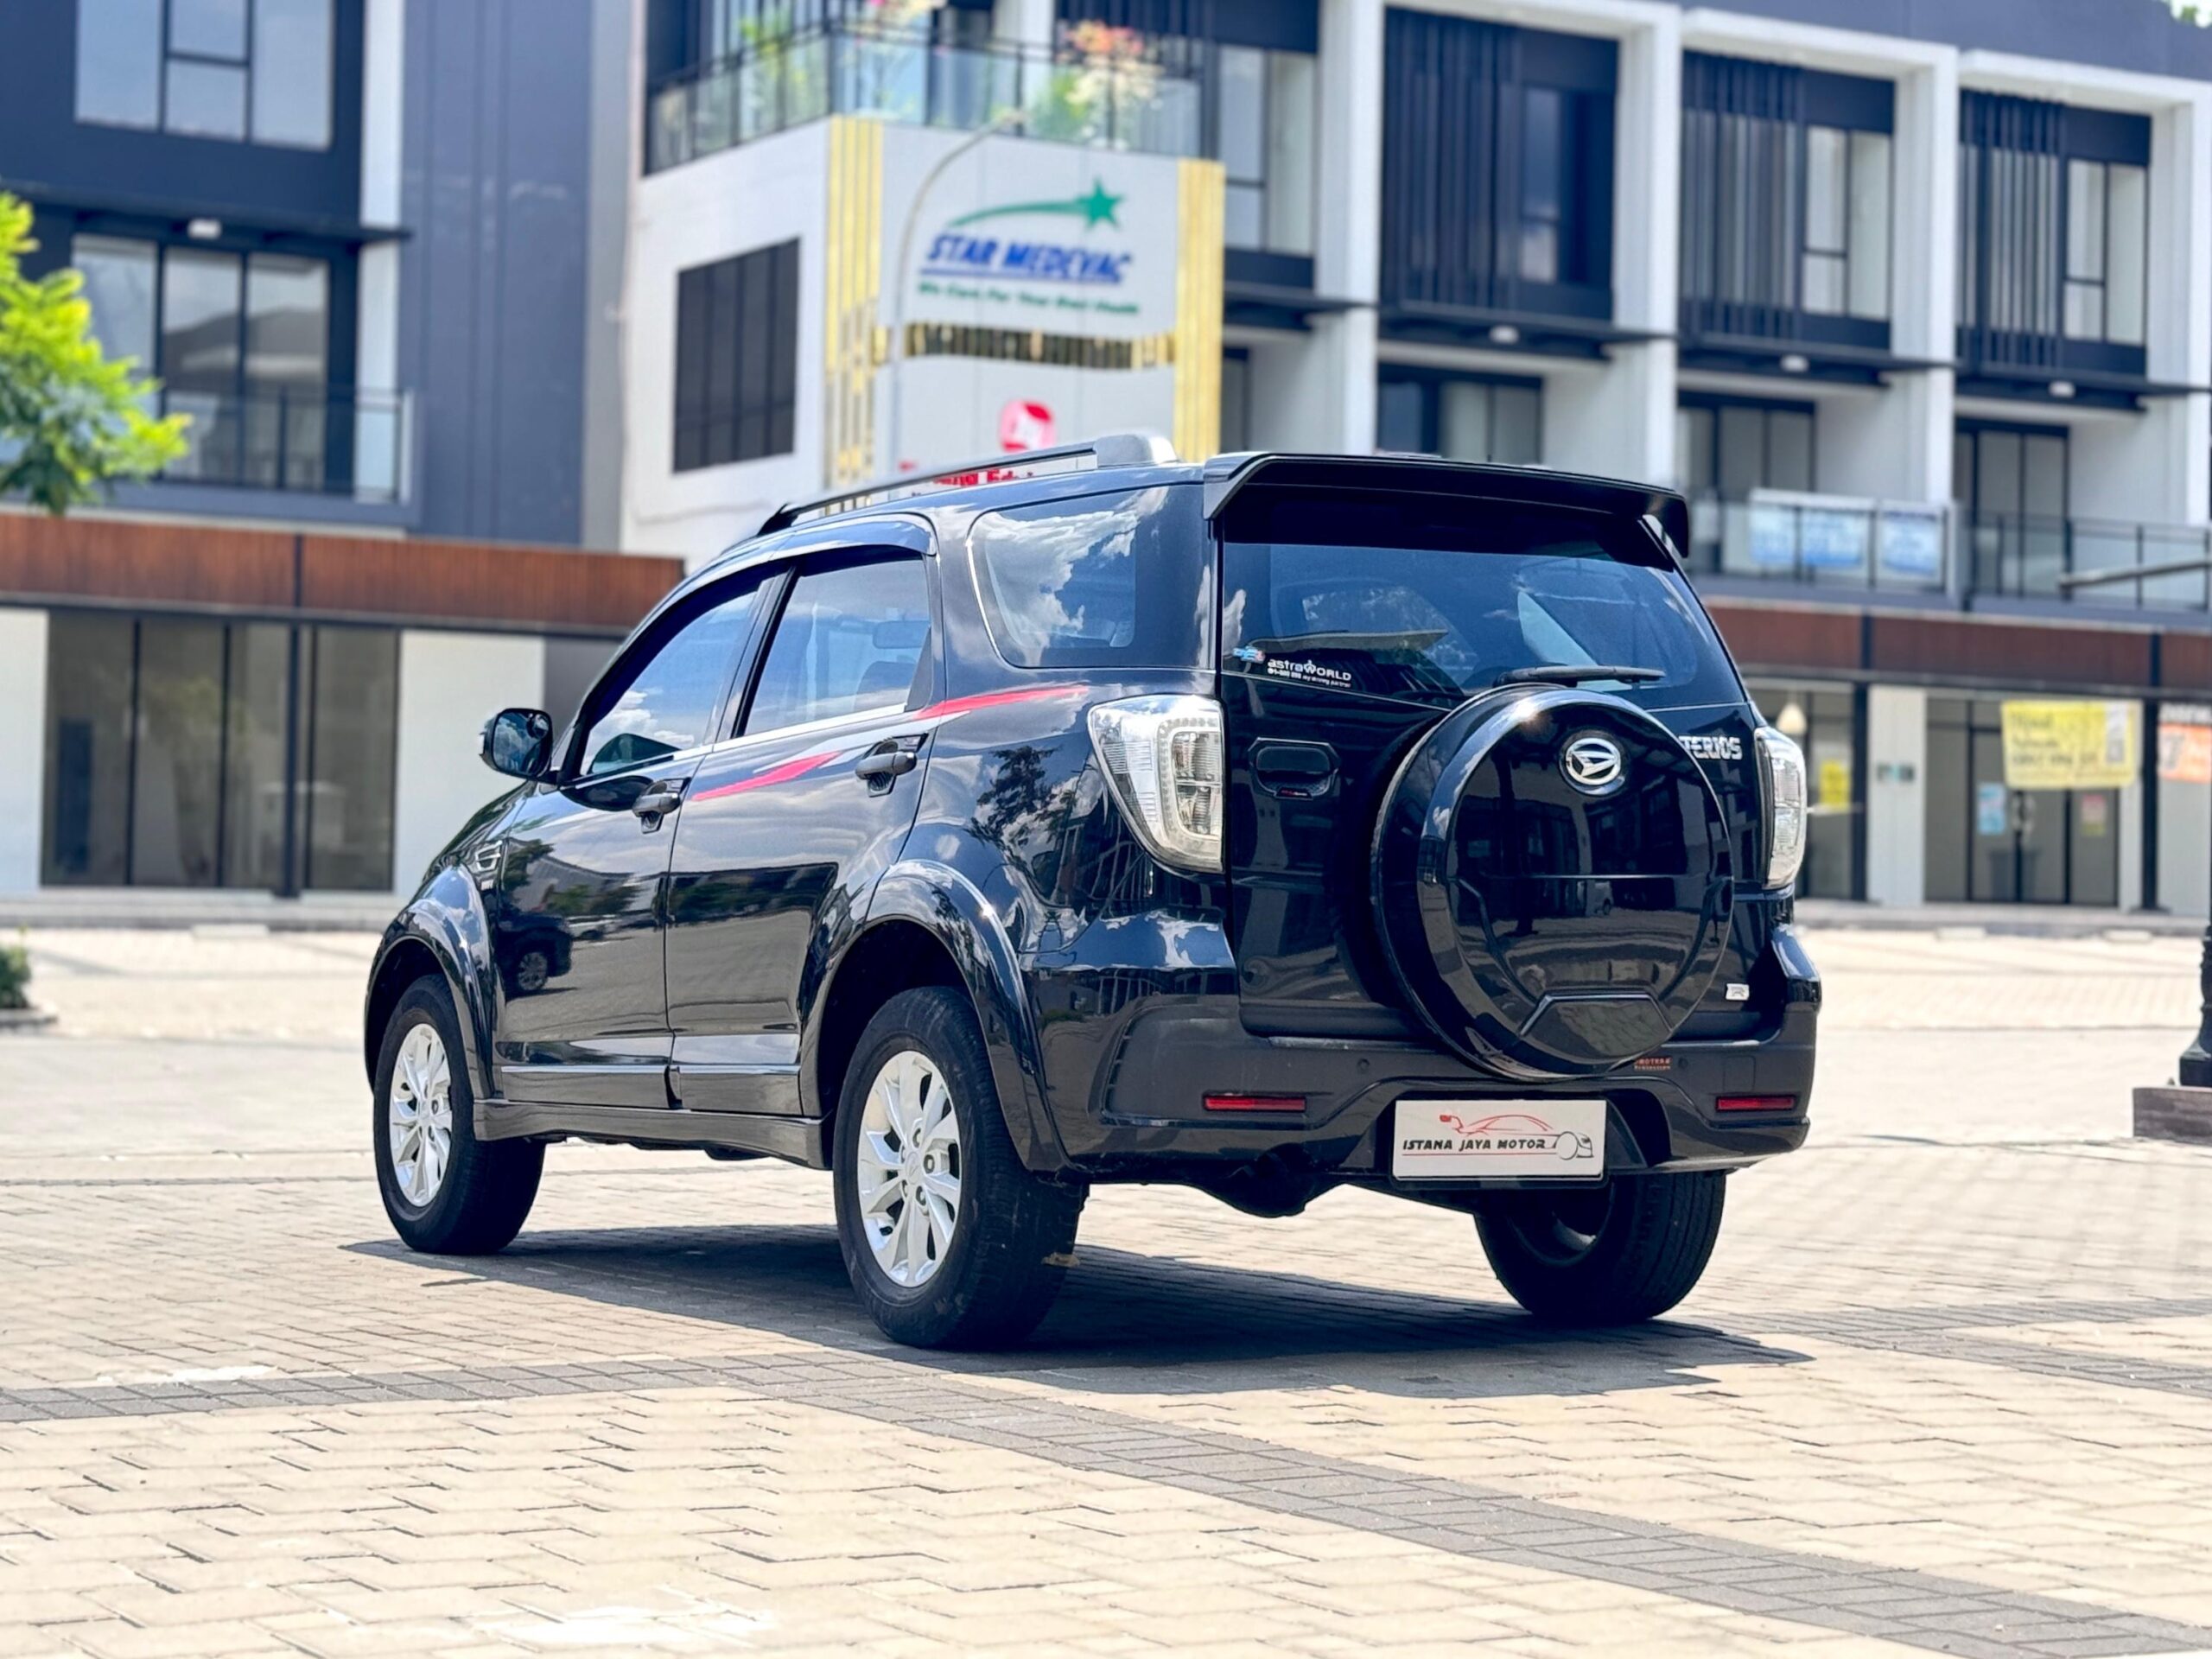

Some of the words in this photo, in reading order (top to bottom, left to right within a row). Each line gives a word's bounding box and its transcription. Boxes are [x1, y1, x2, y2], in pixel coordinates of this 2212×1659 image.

[927, 235, 998, 265] STAR
[1678, 735, 1743, 760] TERIOS
[1402, 1139, 1452, 1150] ISTANA
[1459, 1139, 1491, 1152] JAYA
[1497, 1138, 1546, 1149] MOTOR
